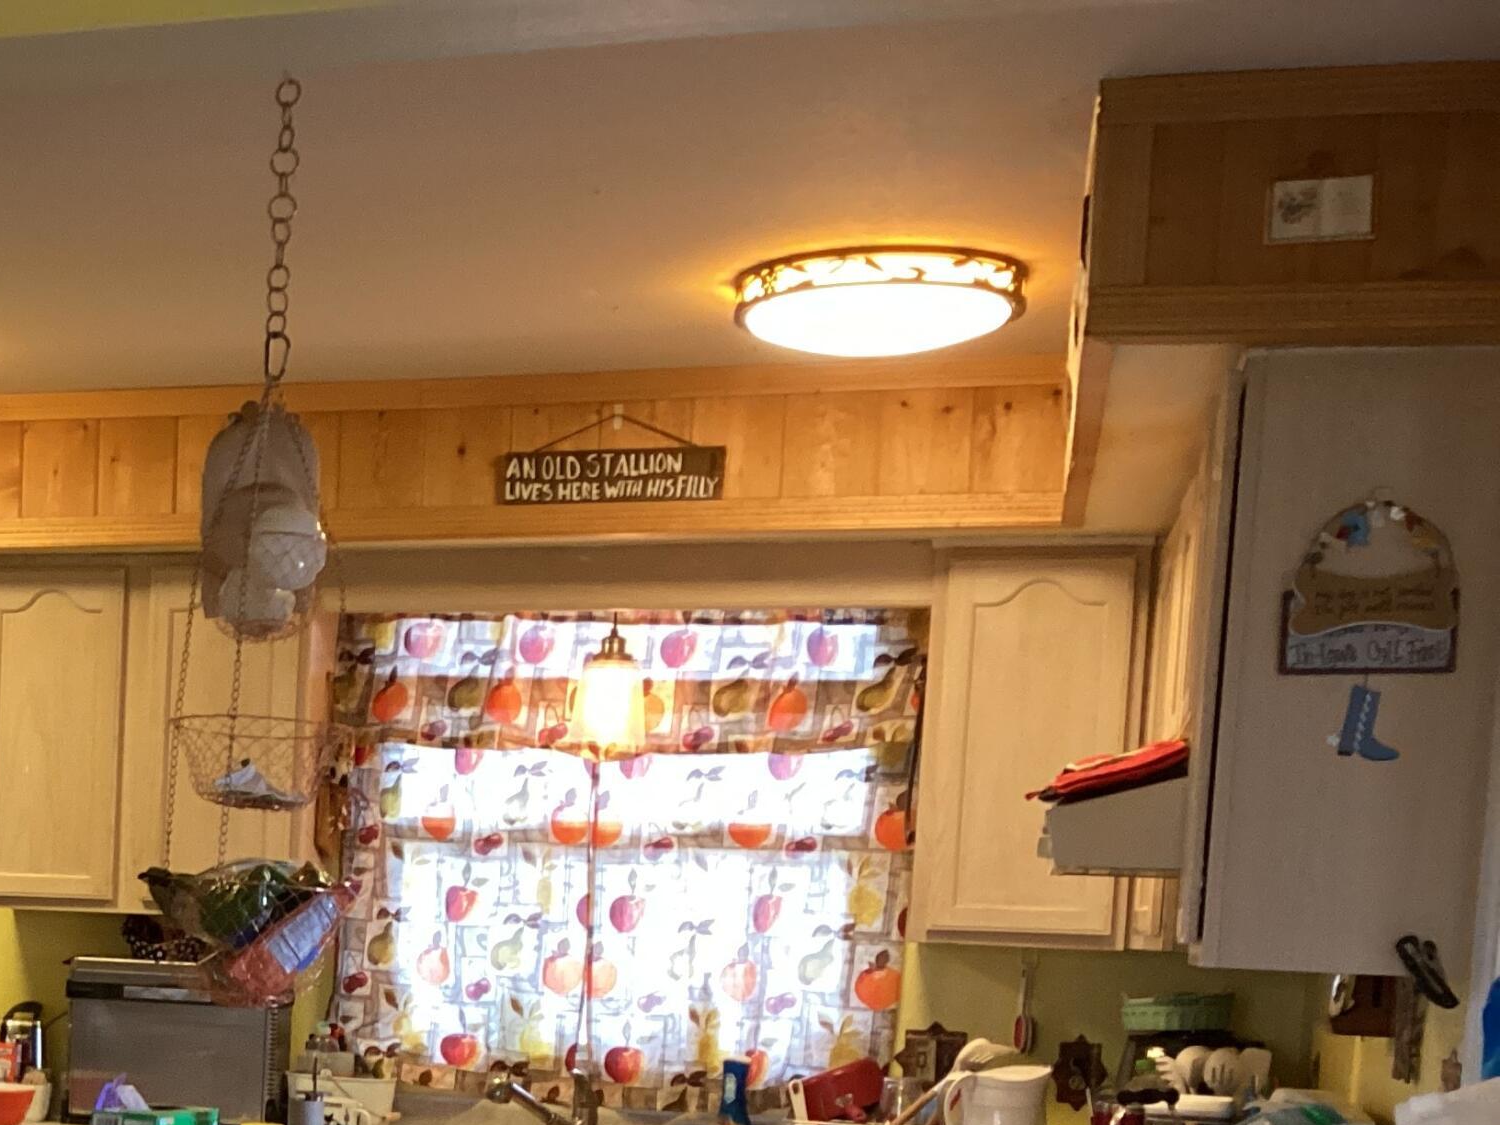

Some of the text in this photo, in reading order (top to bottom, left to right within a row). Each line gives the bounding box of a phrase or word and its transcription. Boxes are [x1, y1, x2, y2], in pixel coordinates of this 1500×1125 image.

[505, 452, 682, 480] AN OLD STALLION
[505, 481, 553, 501] LIVES
[557, 481, 601, 501] HERE
[603, 480, 643, 499] WITH
